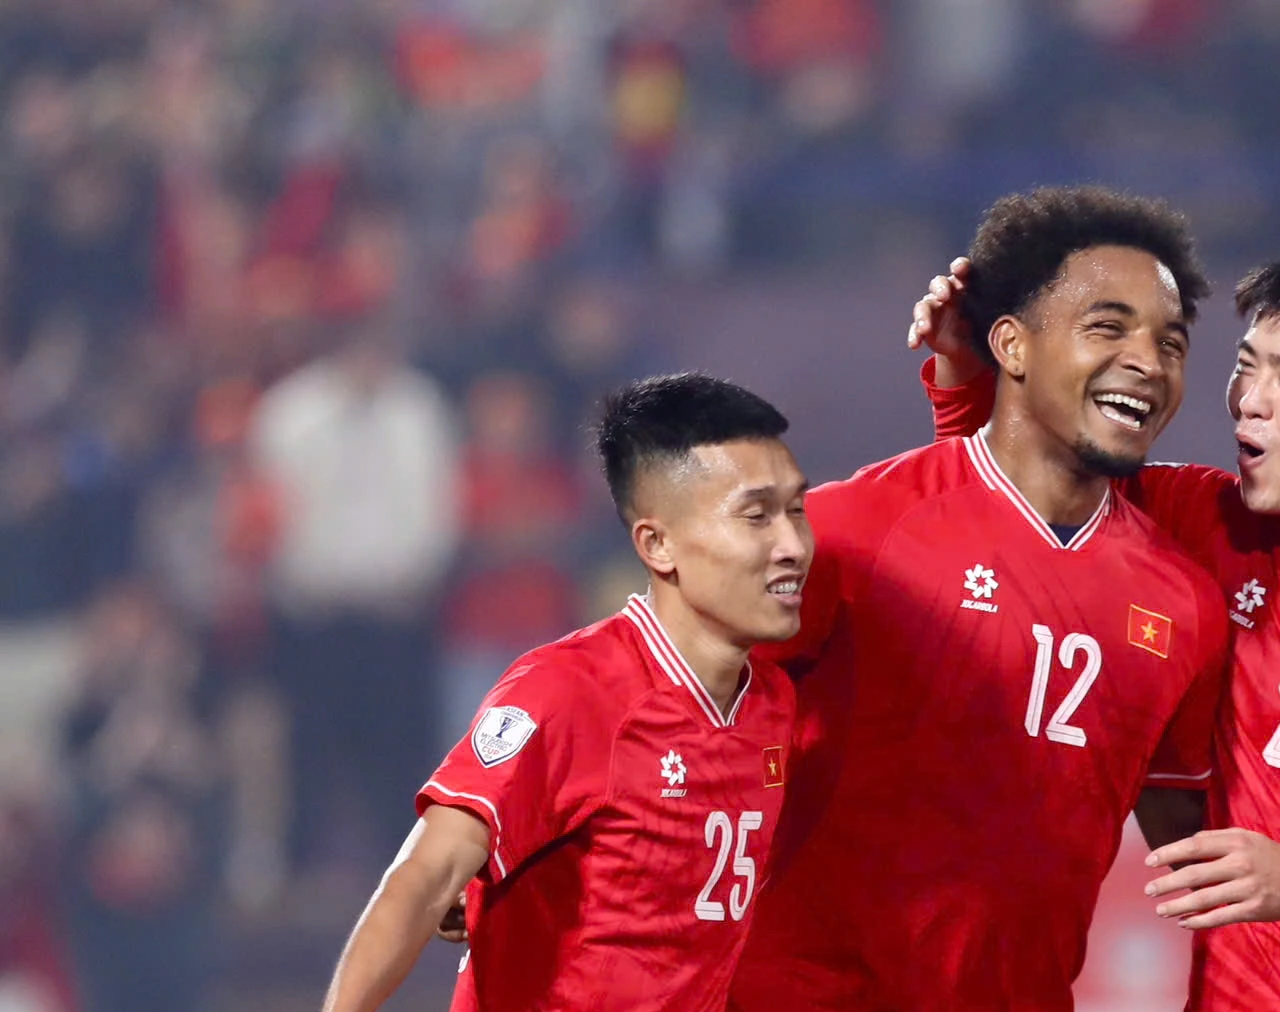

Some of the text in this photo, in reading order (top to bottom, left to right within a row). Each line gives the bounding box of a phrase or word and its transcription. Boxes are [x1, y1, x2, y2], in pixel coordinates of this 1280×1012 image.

[1025, 624, 1101, 747] 12
[481, 746, 499, 755] CUP
[695, 811, 763, 921] 25
